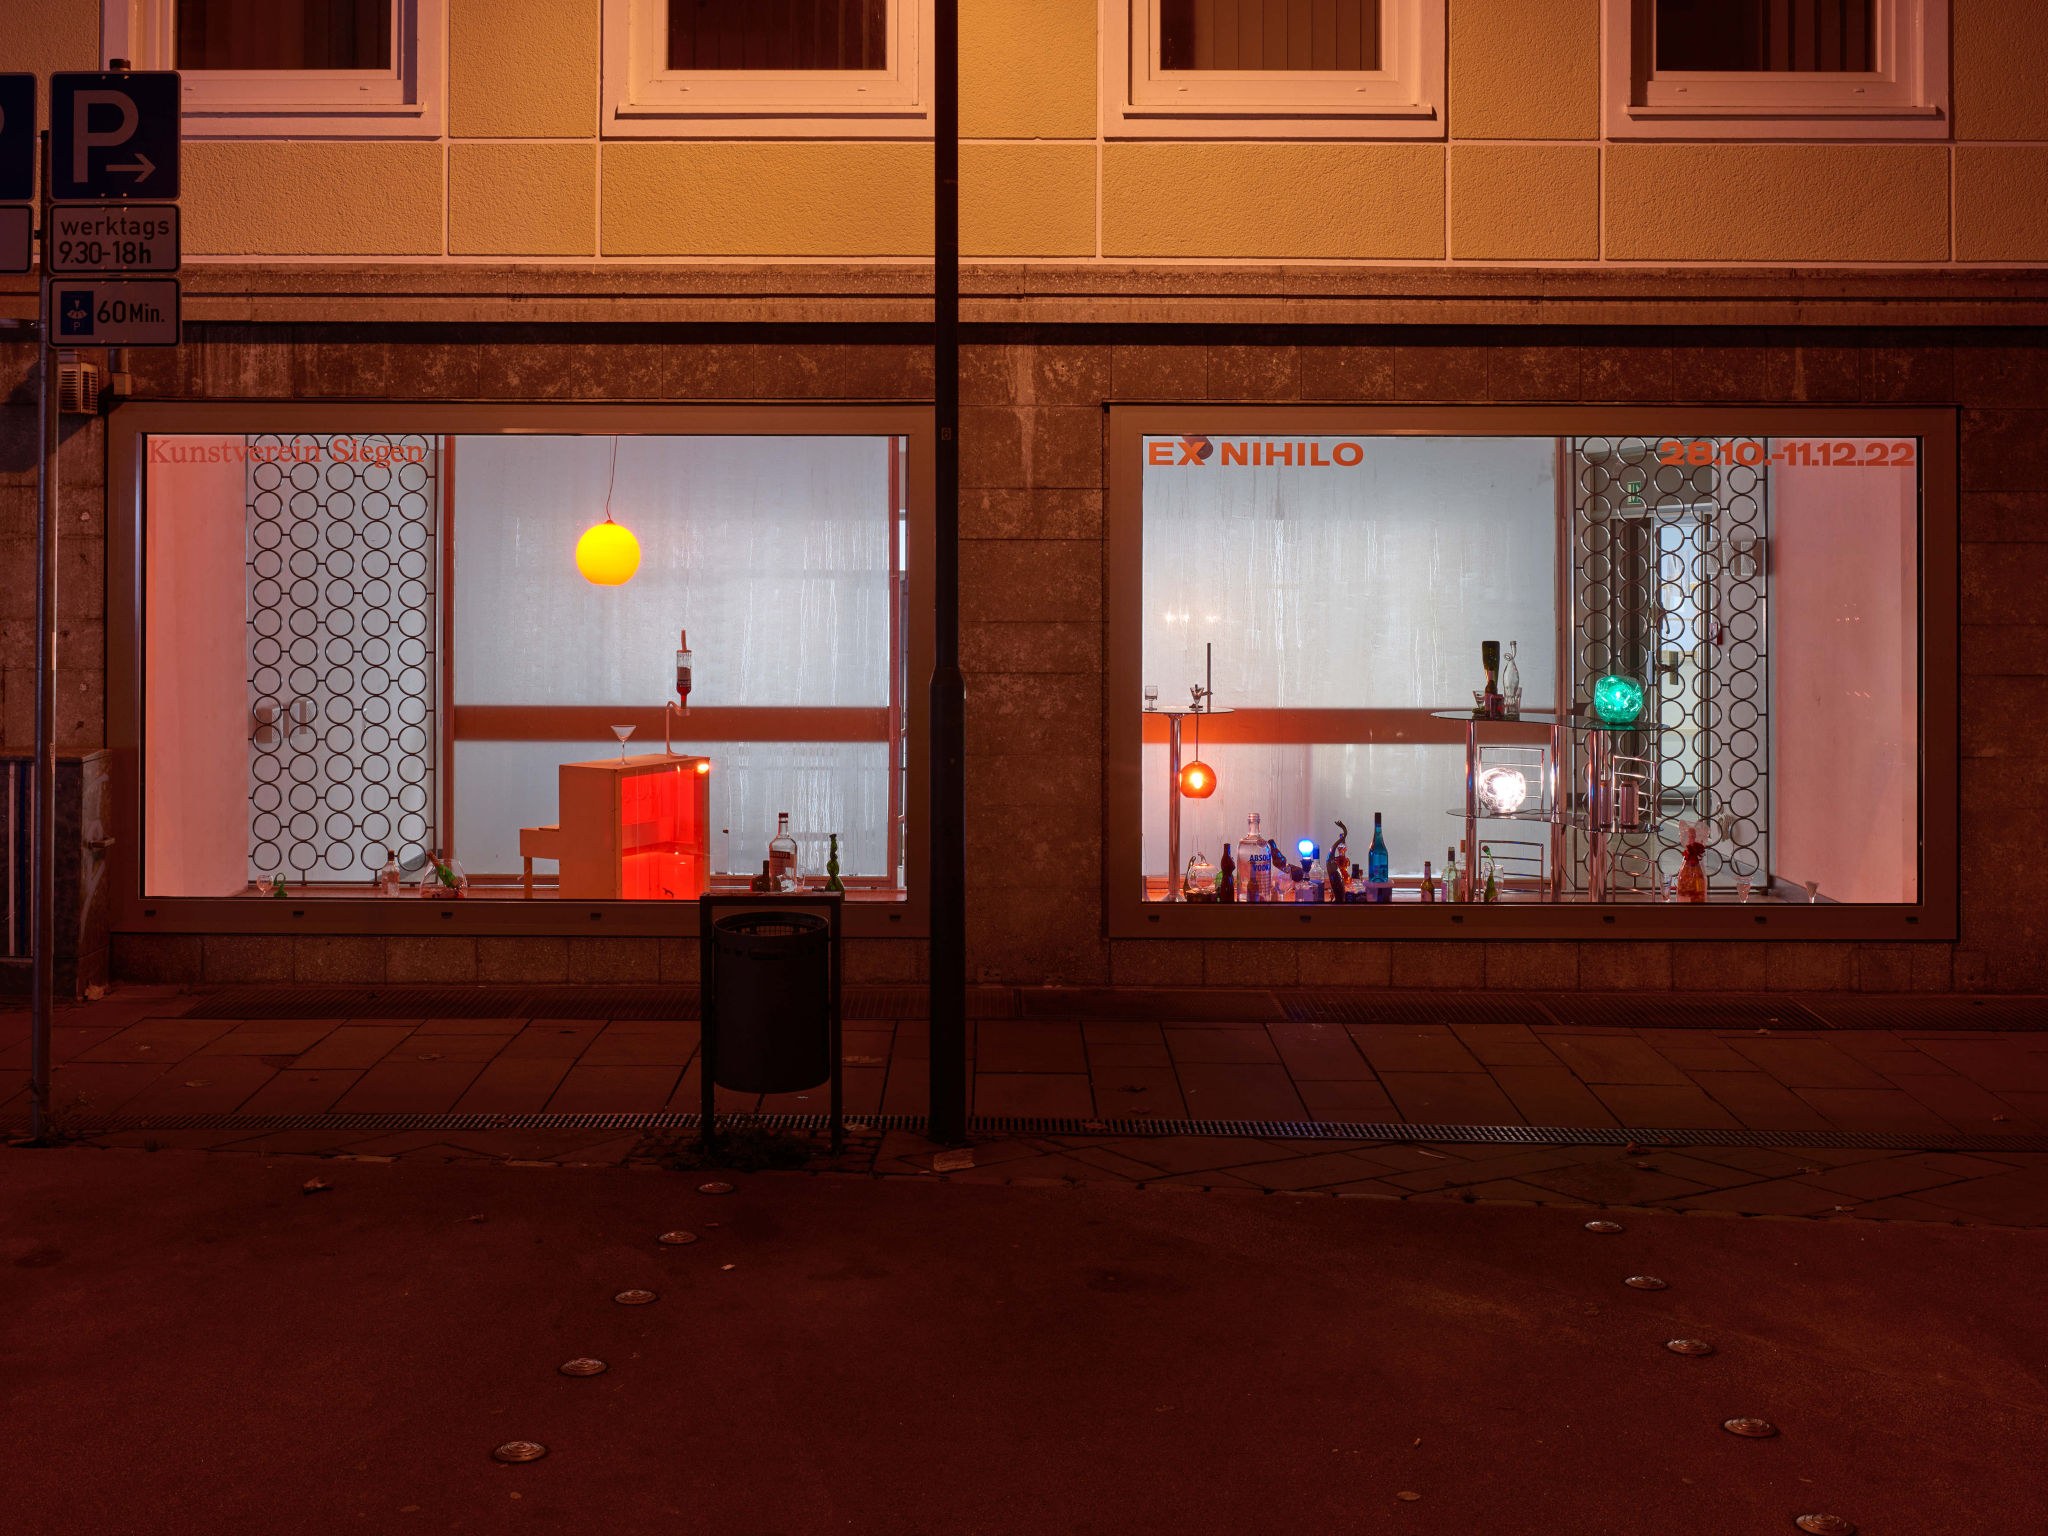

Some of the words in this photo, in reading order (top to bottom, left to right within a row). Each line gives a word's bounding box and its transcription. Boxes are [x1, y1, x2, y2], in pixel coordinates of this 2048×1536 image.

[73, 90, 139, 183] P
[61, 216, 169, 240] werktags
[59, 240, 152, 264] 9.30-18h
[97, 300, 127, 324] 60
[129, 303, 165, 322] Min.
[149, 440, 322, 463] Kunstverein
[332, 439, 424, 468] Siegen
[1149, 442, 1206, 466] EX
[1221, 442, 1364, 466] NIHILO
[1660, 441, 1915, 466] 28.10.-11.12.22
